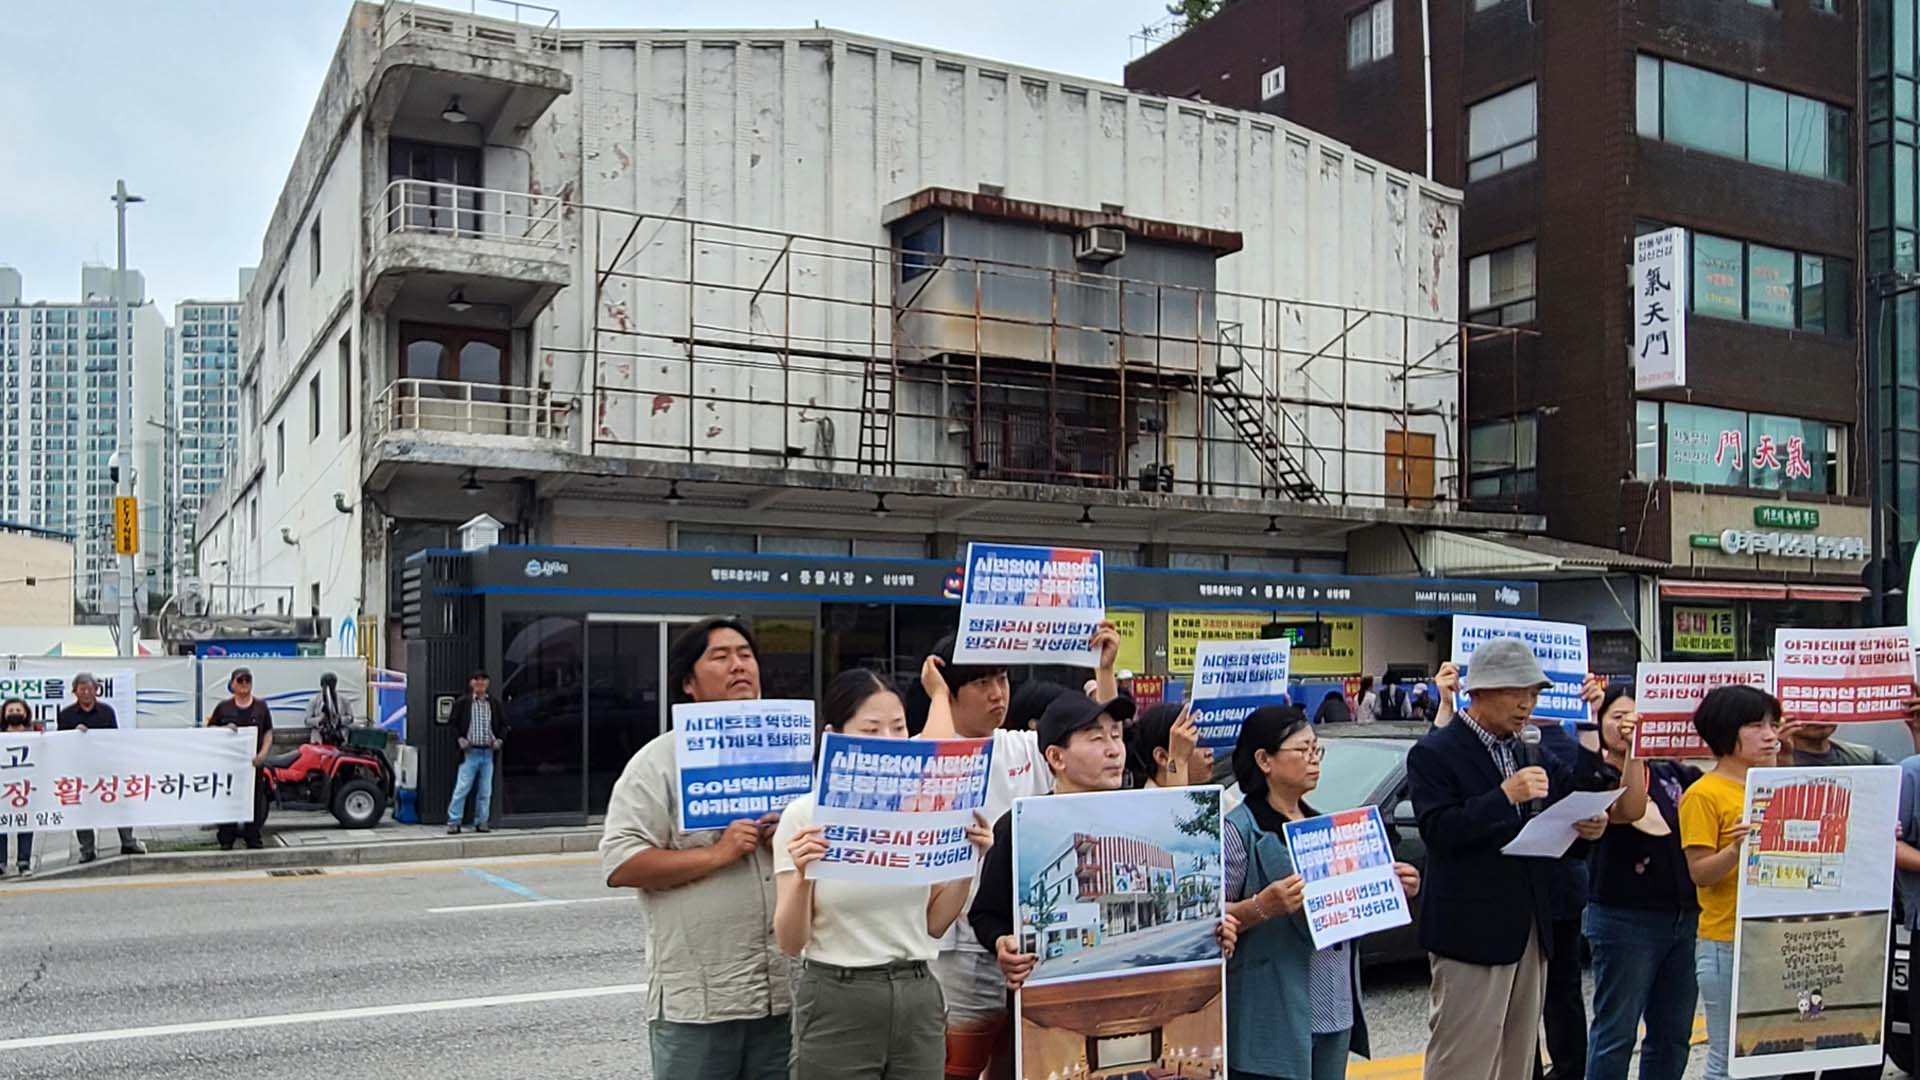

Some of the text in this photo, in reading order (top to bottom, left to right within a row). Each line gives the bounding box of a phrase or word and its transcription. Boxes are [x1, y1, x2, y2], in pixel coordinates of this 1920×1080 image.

[1415, 591, 1477, 603] SMART BUS SHELTER
[1676, 611, 1732, 636] 임대 1층
[965, 636, 1029, 651] 원주시는
[1783, 653, 1855, 666] 주차장이
[1644, 688, 1704, 700] 주차장이
[1198, 724, 1237, 738] 카데미
[54, 772, 233, 806] 활성화하라!
[686, 777, 774, 796] 60년역사
[687, 796, 769, 816] 아카데미
[823, 825, 913, 846] 절차무시
[914, 844, 973, 868] 각성하라
